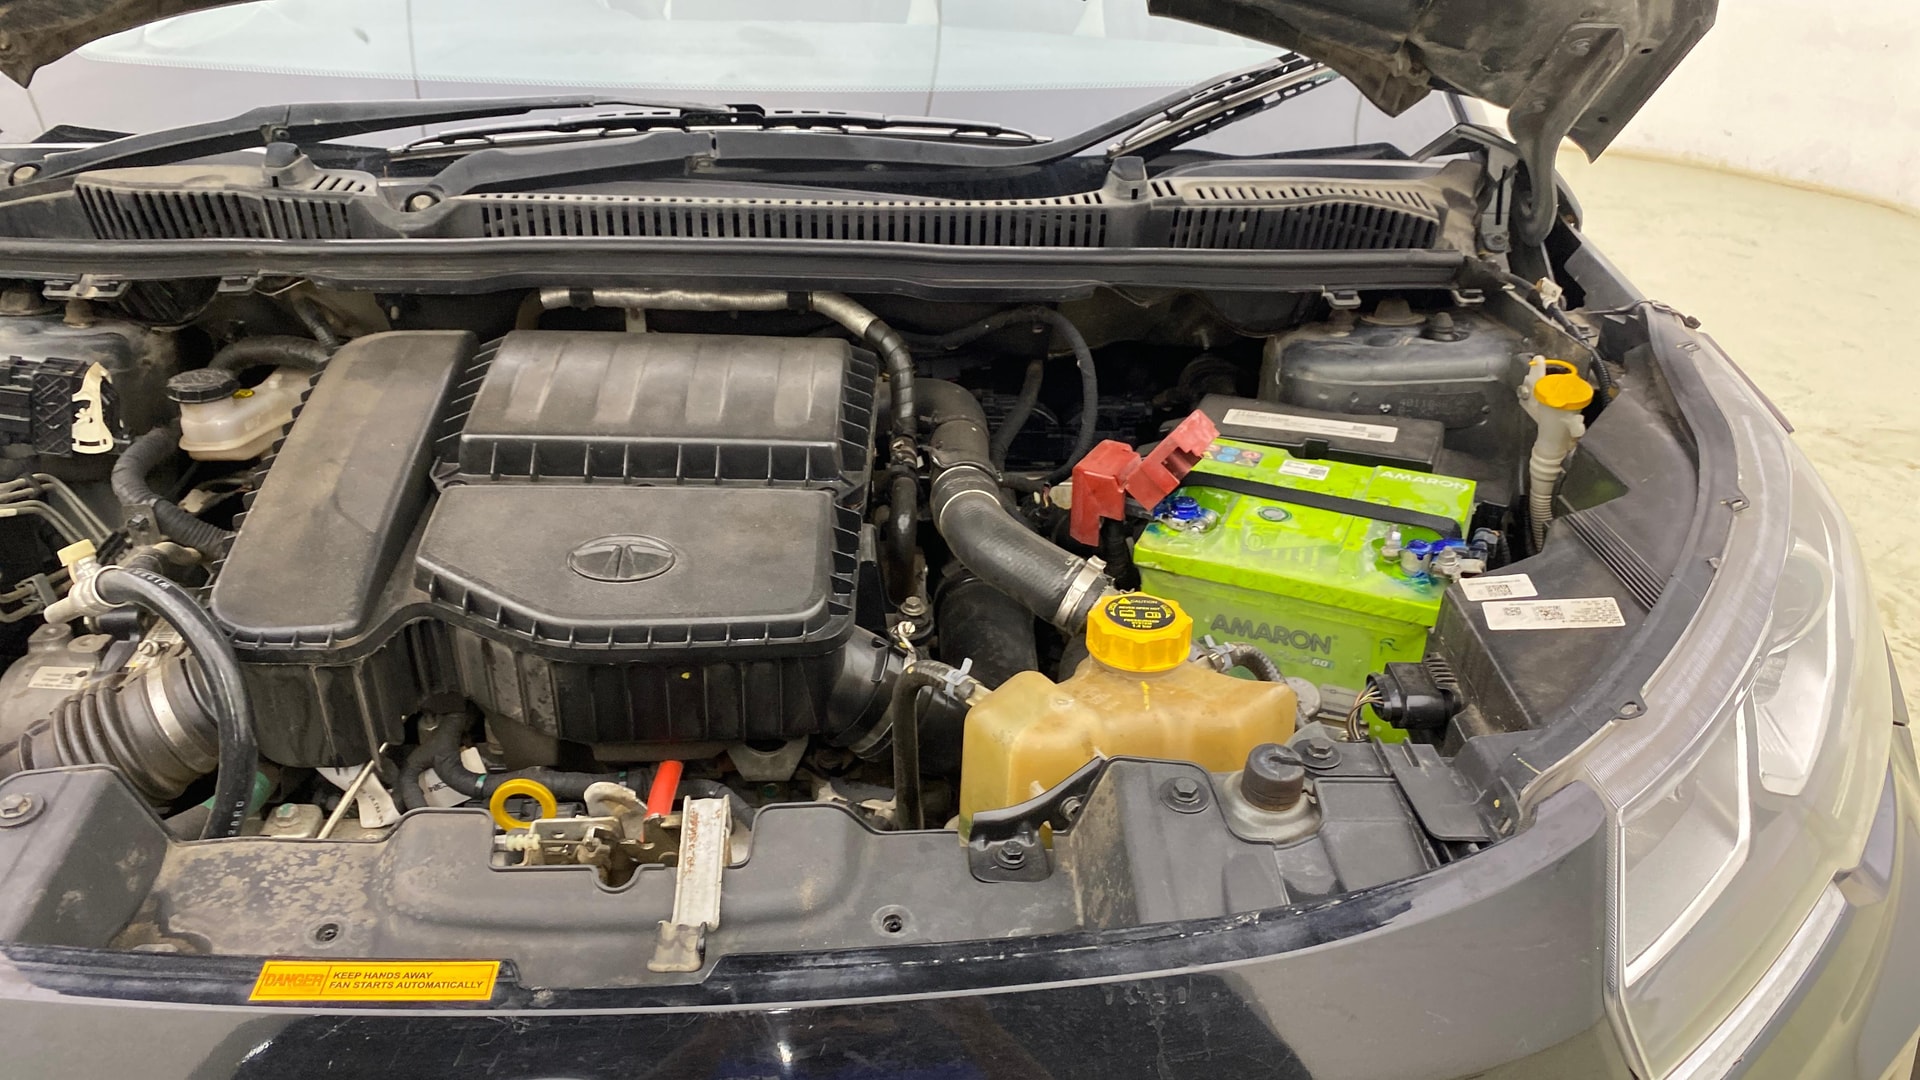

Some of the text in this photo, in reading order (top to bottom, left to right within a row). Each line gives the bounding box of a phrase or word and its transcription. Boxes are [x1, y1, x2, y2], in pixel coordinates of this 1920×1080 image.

[1379, 470, 1470, 492] AMARON
[1211, 614, 1332, 654] AMARON
[264, 972, 325, 987] DANGER
[333, 971, 434, 979] KEEP HANDS AWAY
[329, 980, 485, 989] FAN STARTS AUTOMATICALLY
